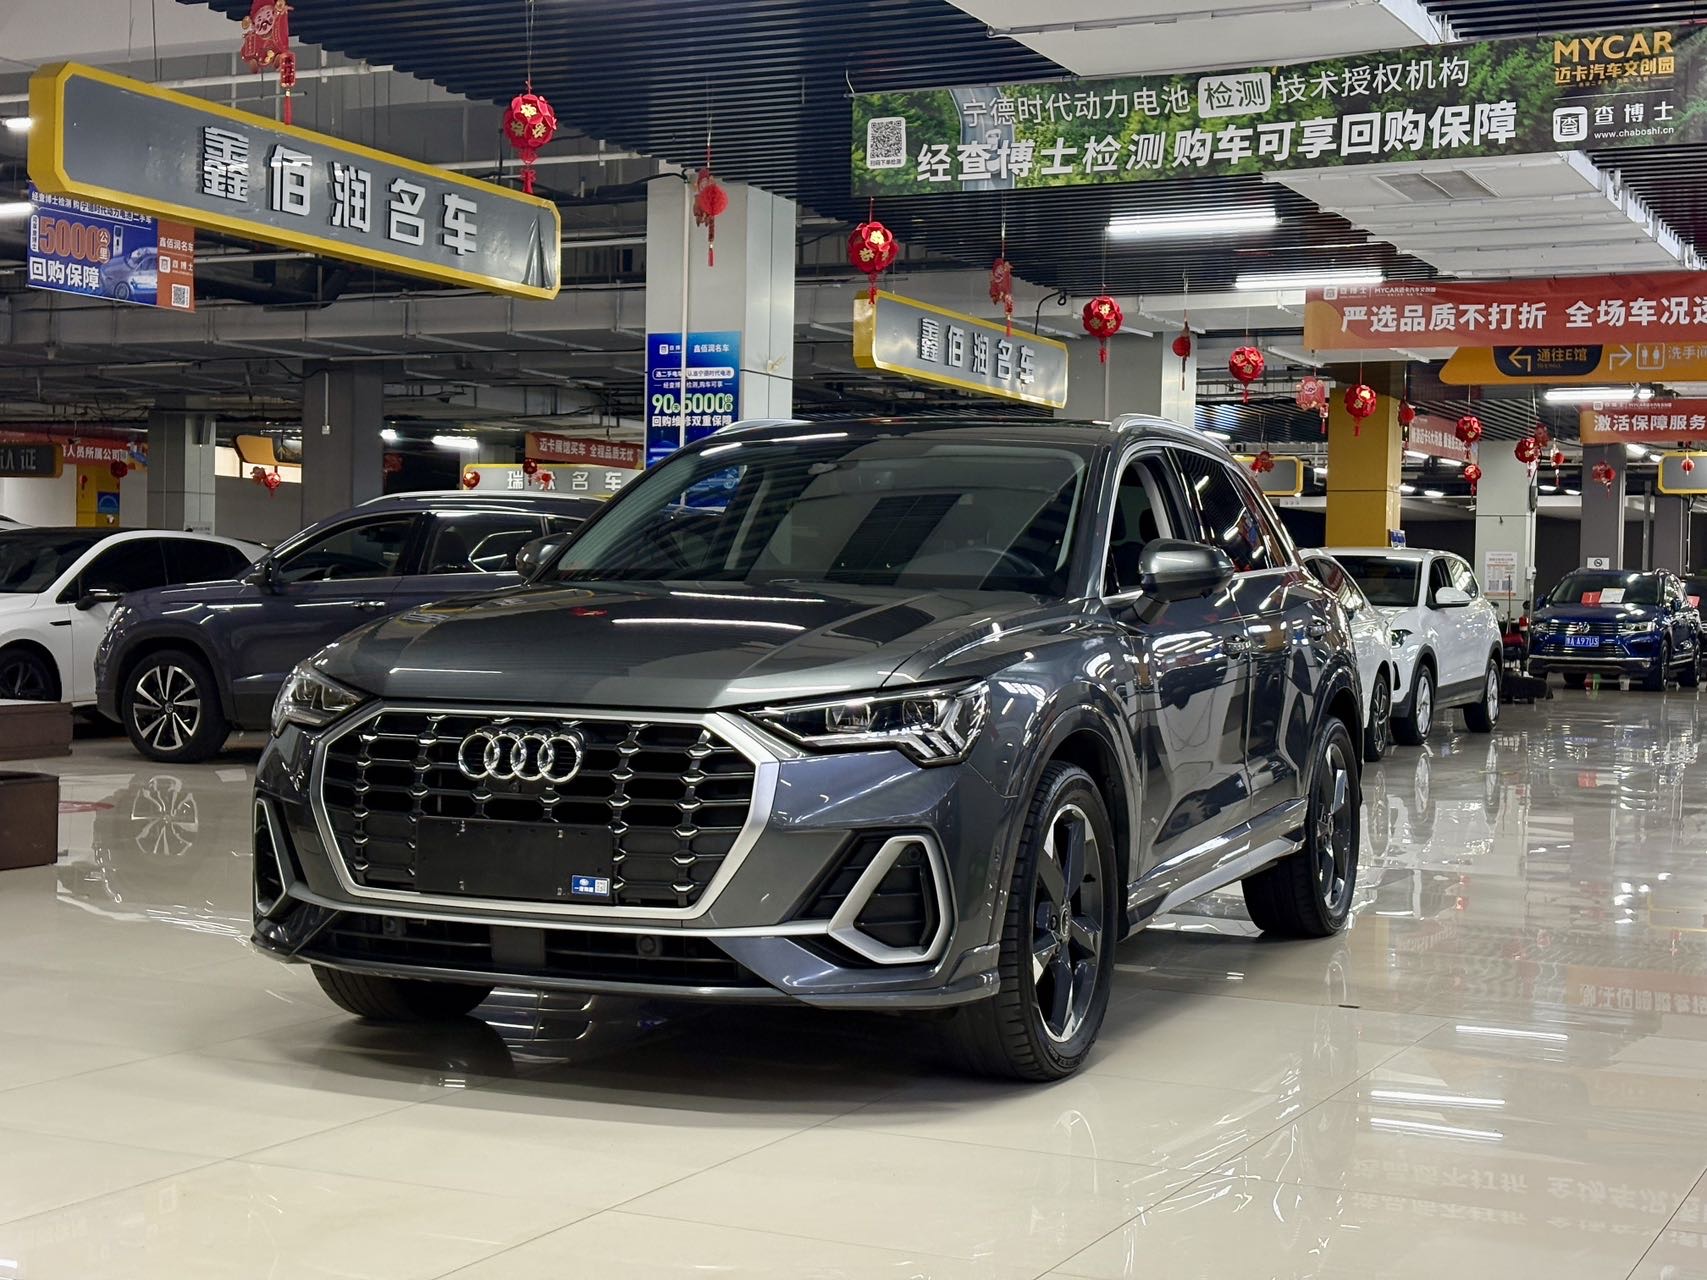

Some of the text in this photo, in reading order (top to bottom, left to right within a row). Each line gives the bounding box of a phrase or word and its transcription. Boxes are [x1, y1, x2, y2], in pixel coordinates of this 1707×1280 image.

[1554, 31, 1674, 64] MYCAR
[1554, 56, 1675, 84] 迈卡汽车文创园
[962, 56, 1470, 127] 宁德时代动力电池 检测 技术授权机构
[1594, 101, 1674, 125] 查博士
[916, 100, 1517, 182] 经查博士检测购车可享回购保障
[1594, 126, 1674, 139] www.chaboshi.cn
[203, 126, 477, 255] 鑫佰润名车
[40, 216, 101, 263] 5000
[159, 236, 194, 252] 鑫佰润名车
[30, 256, 100, 291] 回购保障
[1341, 301, 1547, 333] 严选品质不打折
[920, 317, 1036, 385] 鑫佰润名车
[652, 394, 674, 414] 90
[1594, 414, 1706, 432] 激活保障服务
